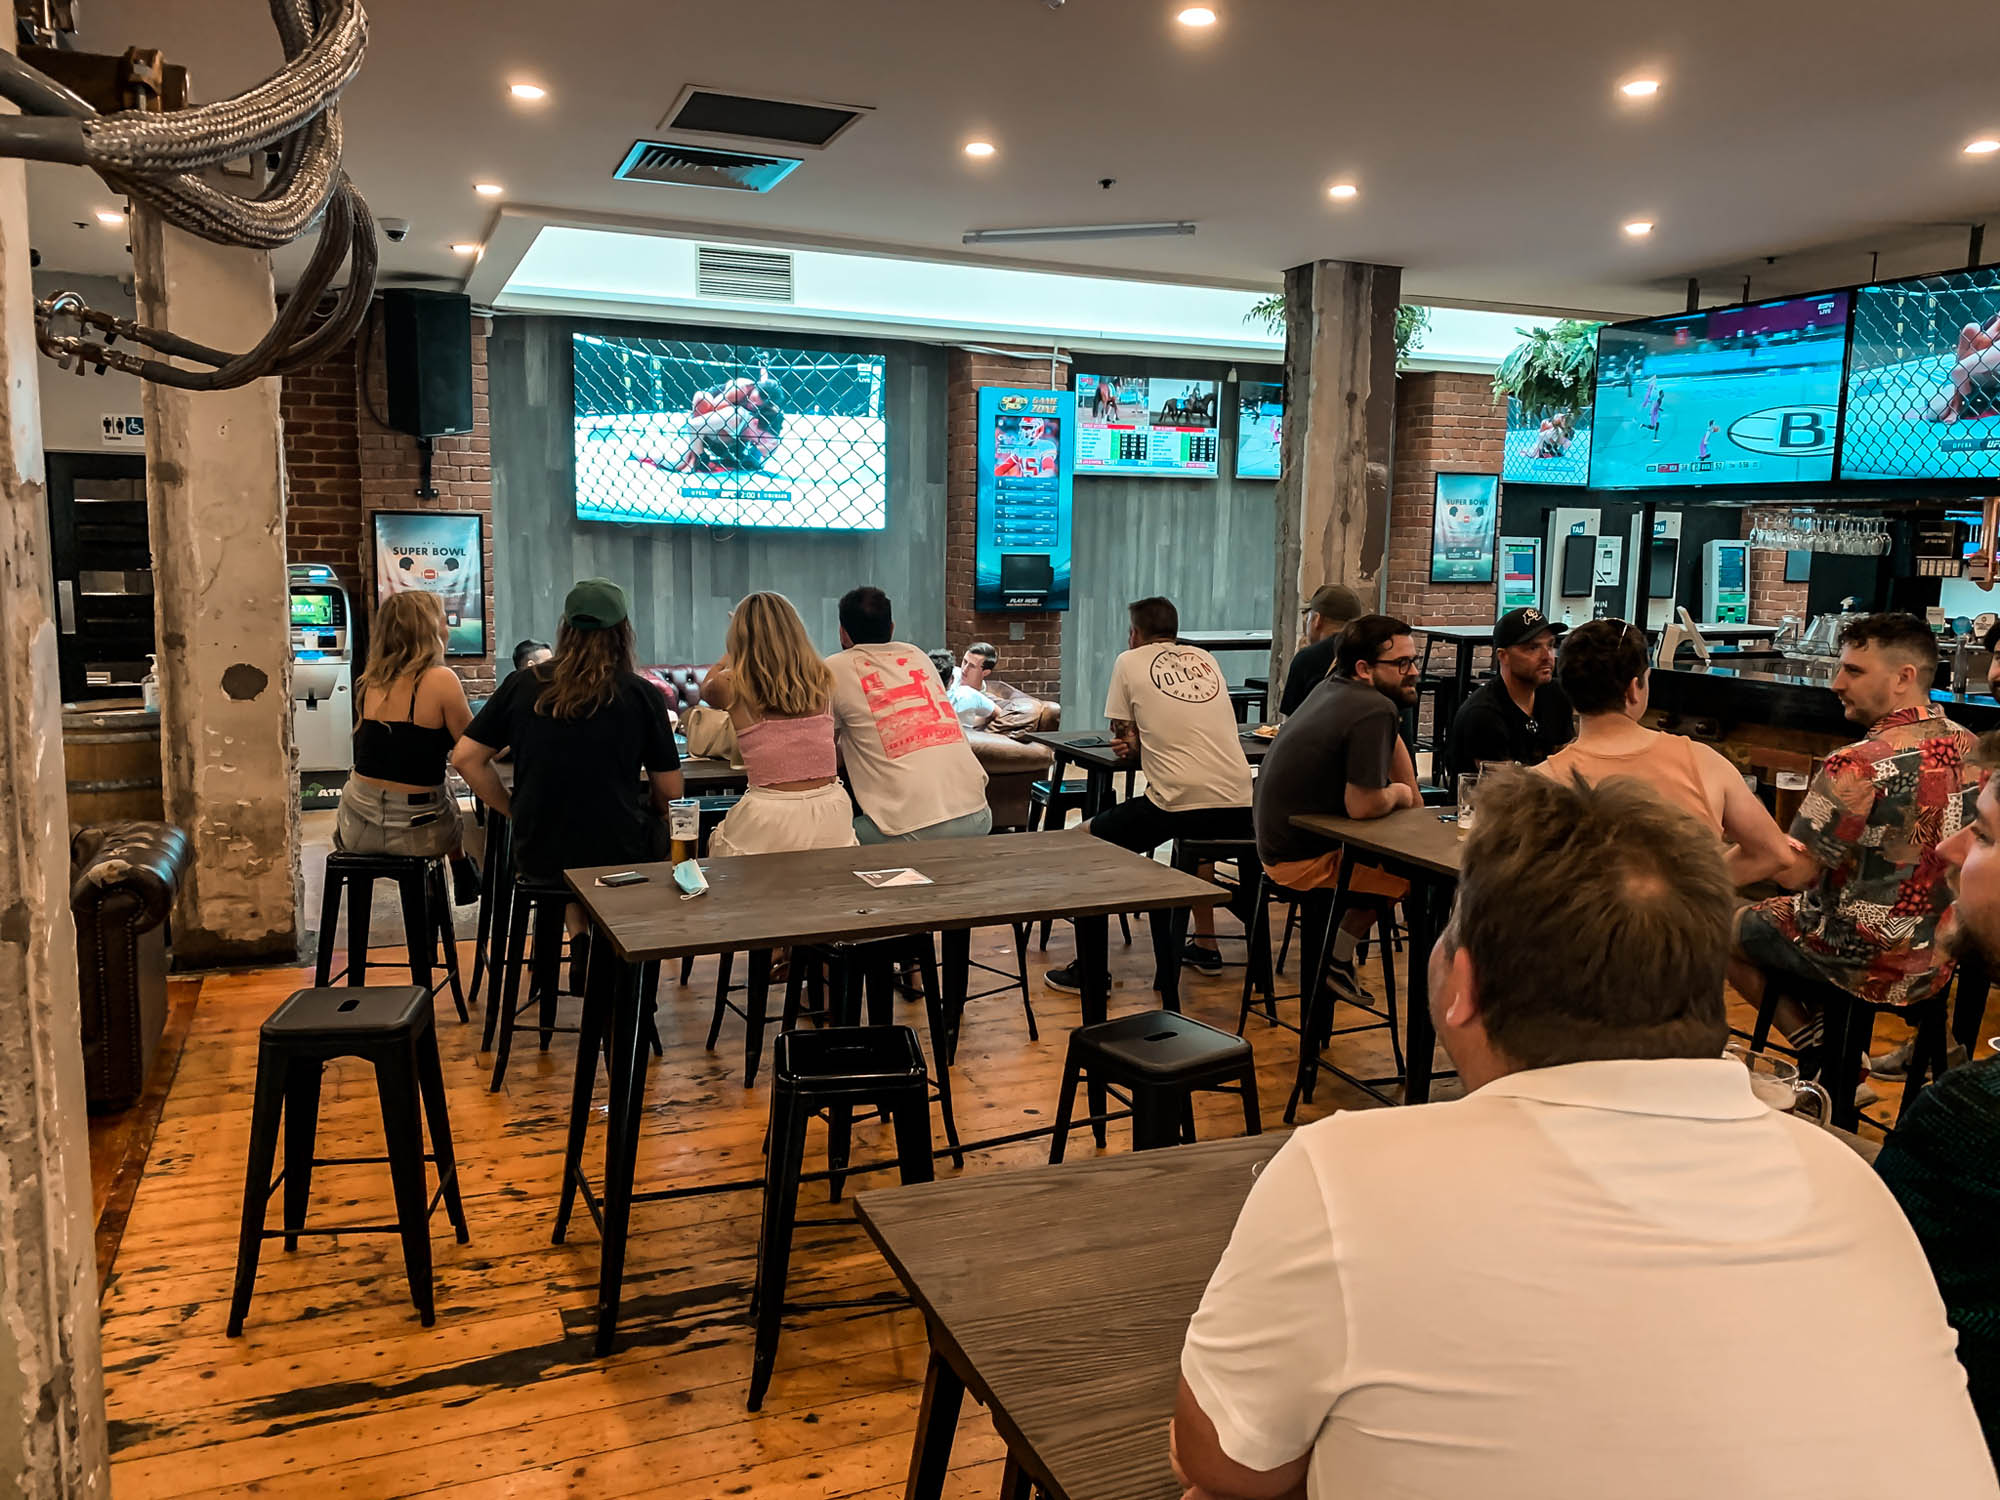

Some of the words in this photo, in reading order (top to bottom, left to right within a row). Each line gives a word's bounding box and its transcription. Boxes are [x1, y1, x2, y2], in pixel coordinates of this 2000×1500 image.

[1779, 412, 1826, 448] B
[740, 491, 756, 499] 2:00
[1654, 524, 1665, 532] TAB
[392, 546, 428, 556] SUPER
[432, 547, 466, 557] BOWL
[291, 604, 315, 613] ATM
